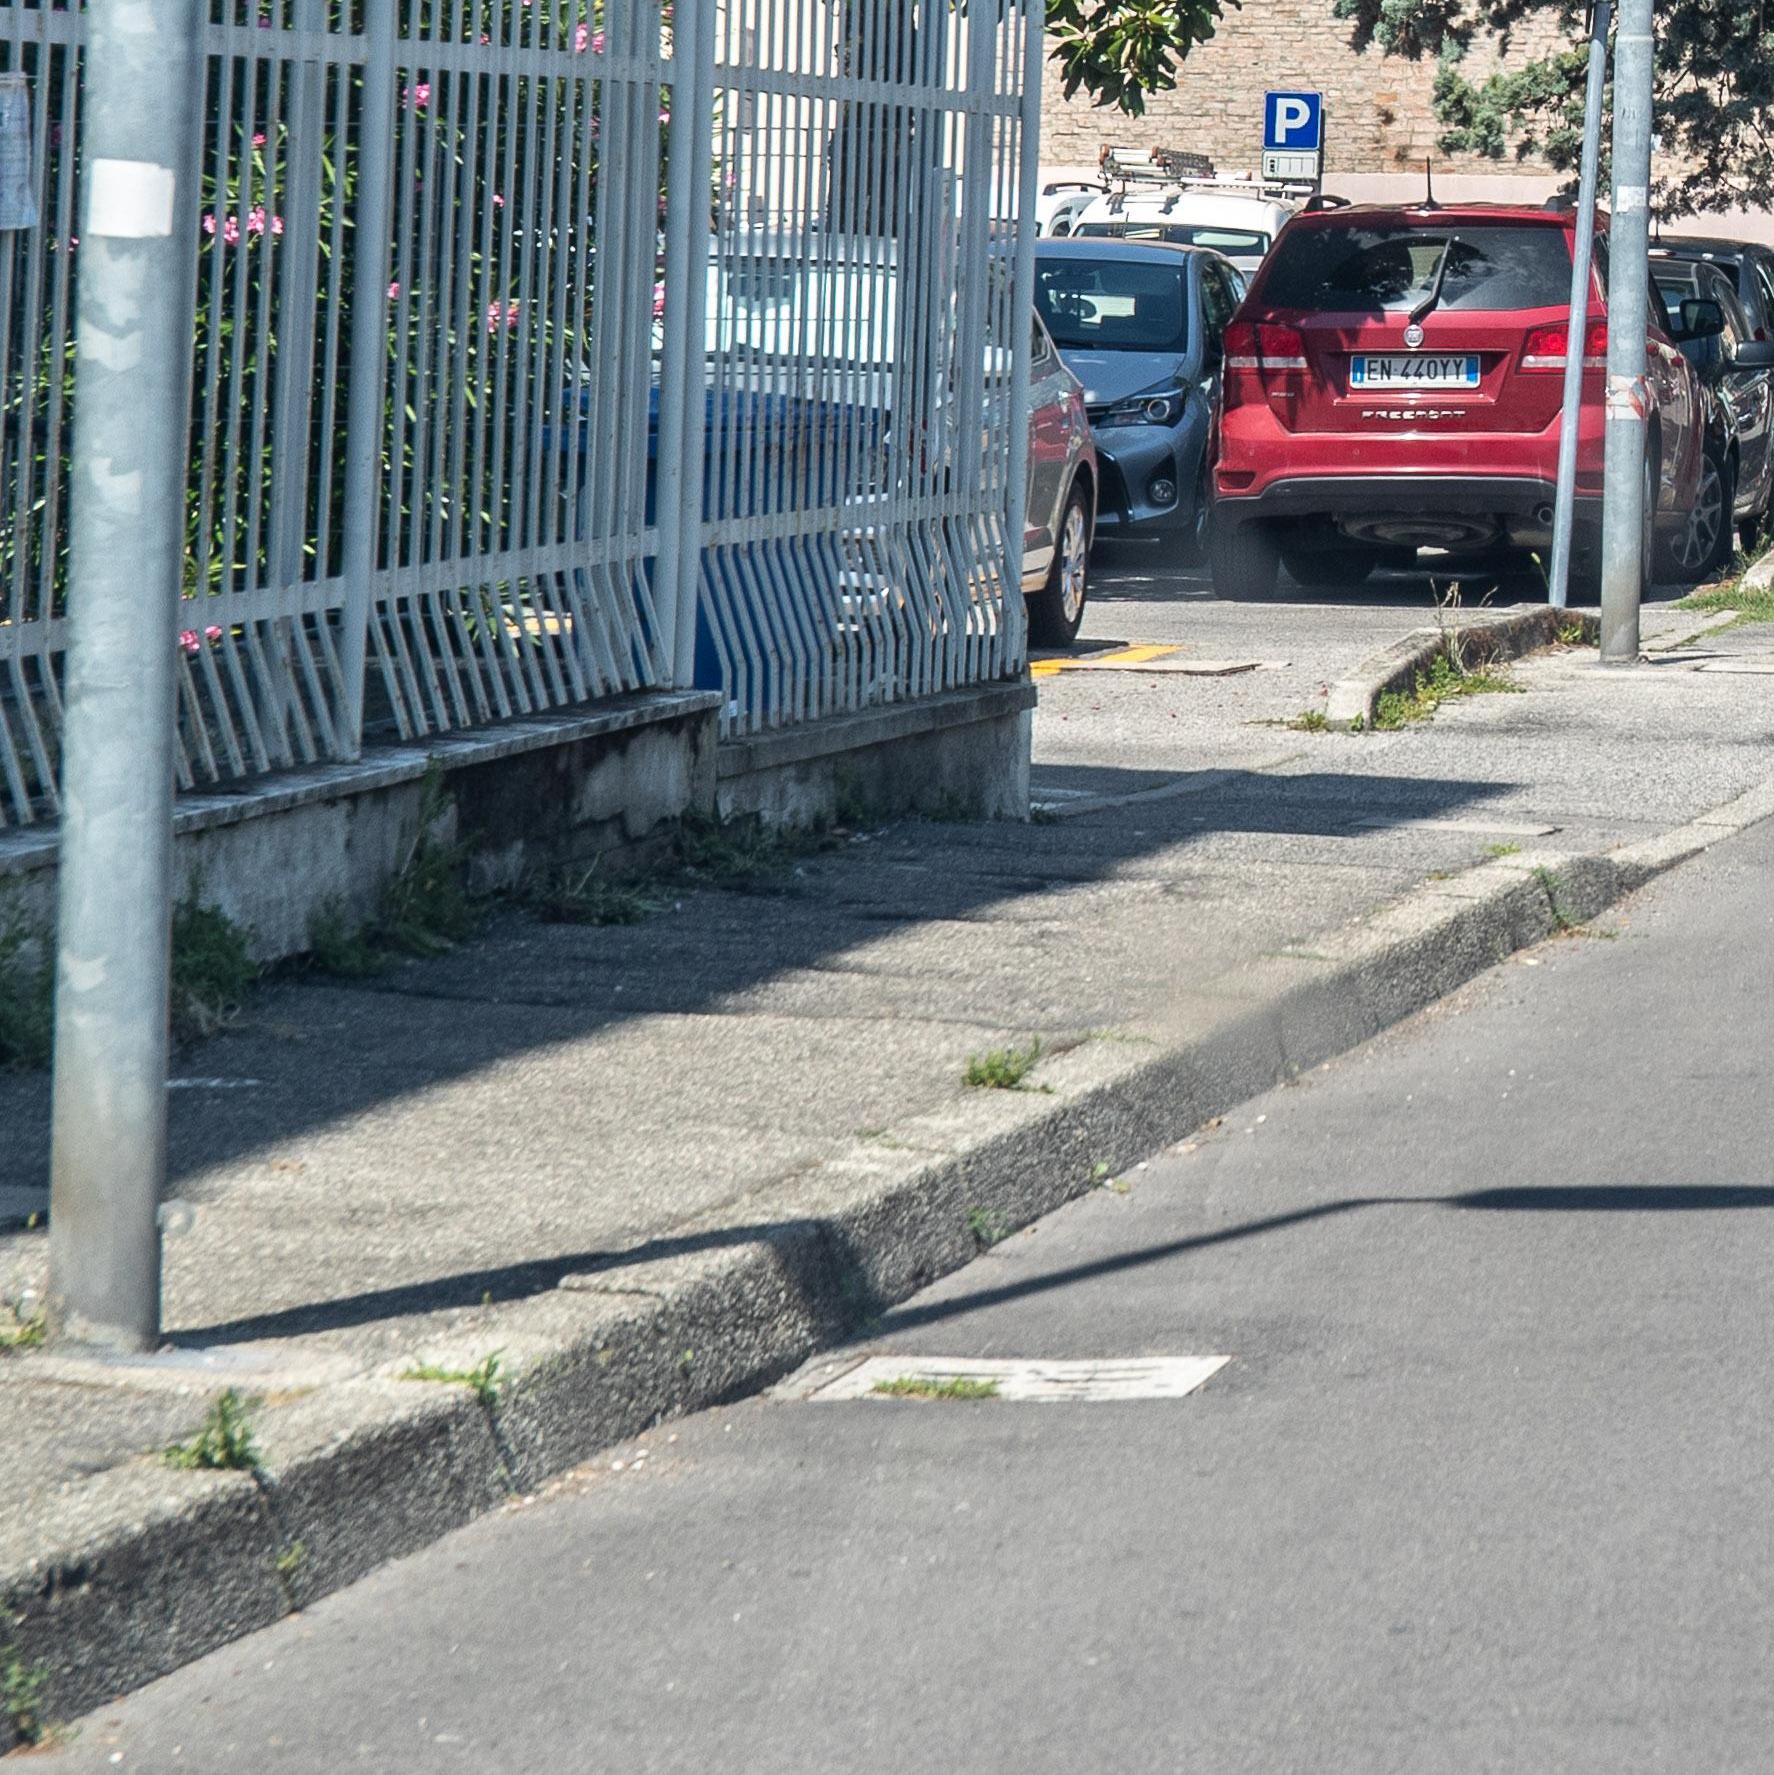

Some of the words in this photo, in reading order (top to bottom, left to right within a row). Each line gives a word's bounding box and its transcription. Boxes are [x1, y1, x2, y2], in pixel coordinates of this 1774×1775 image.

[1275, 98, 1310, 143] P
[1367, 359, 1391, 380] EN
[1401, 359, 1465, 380] 440YY
